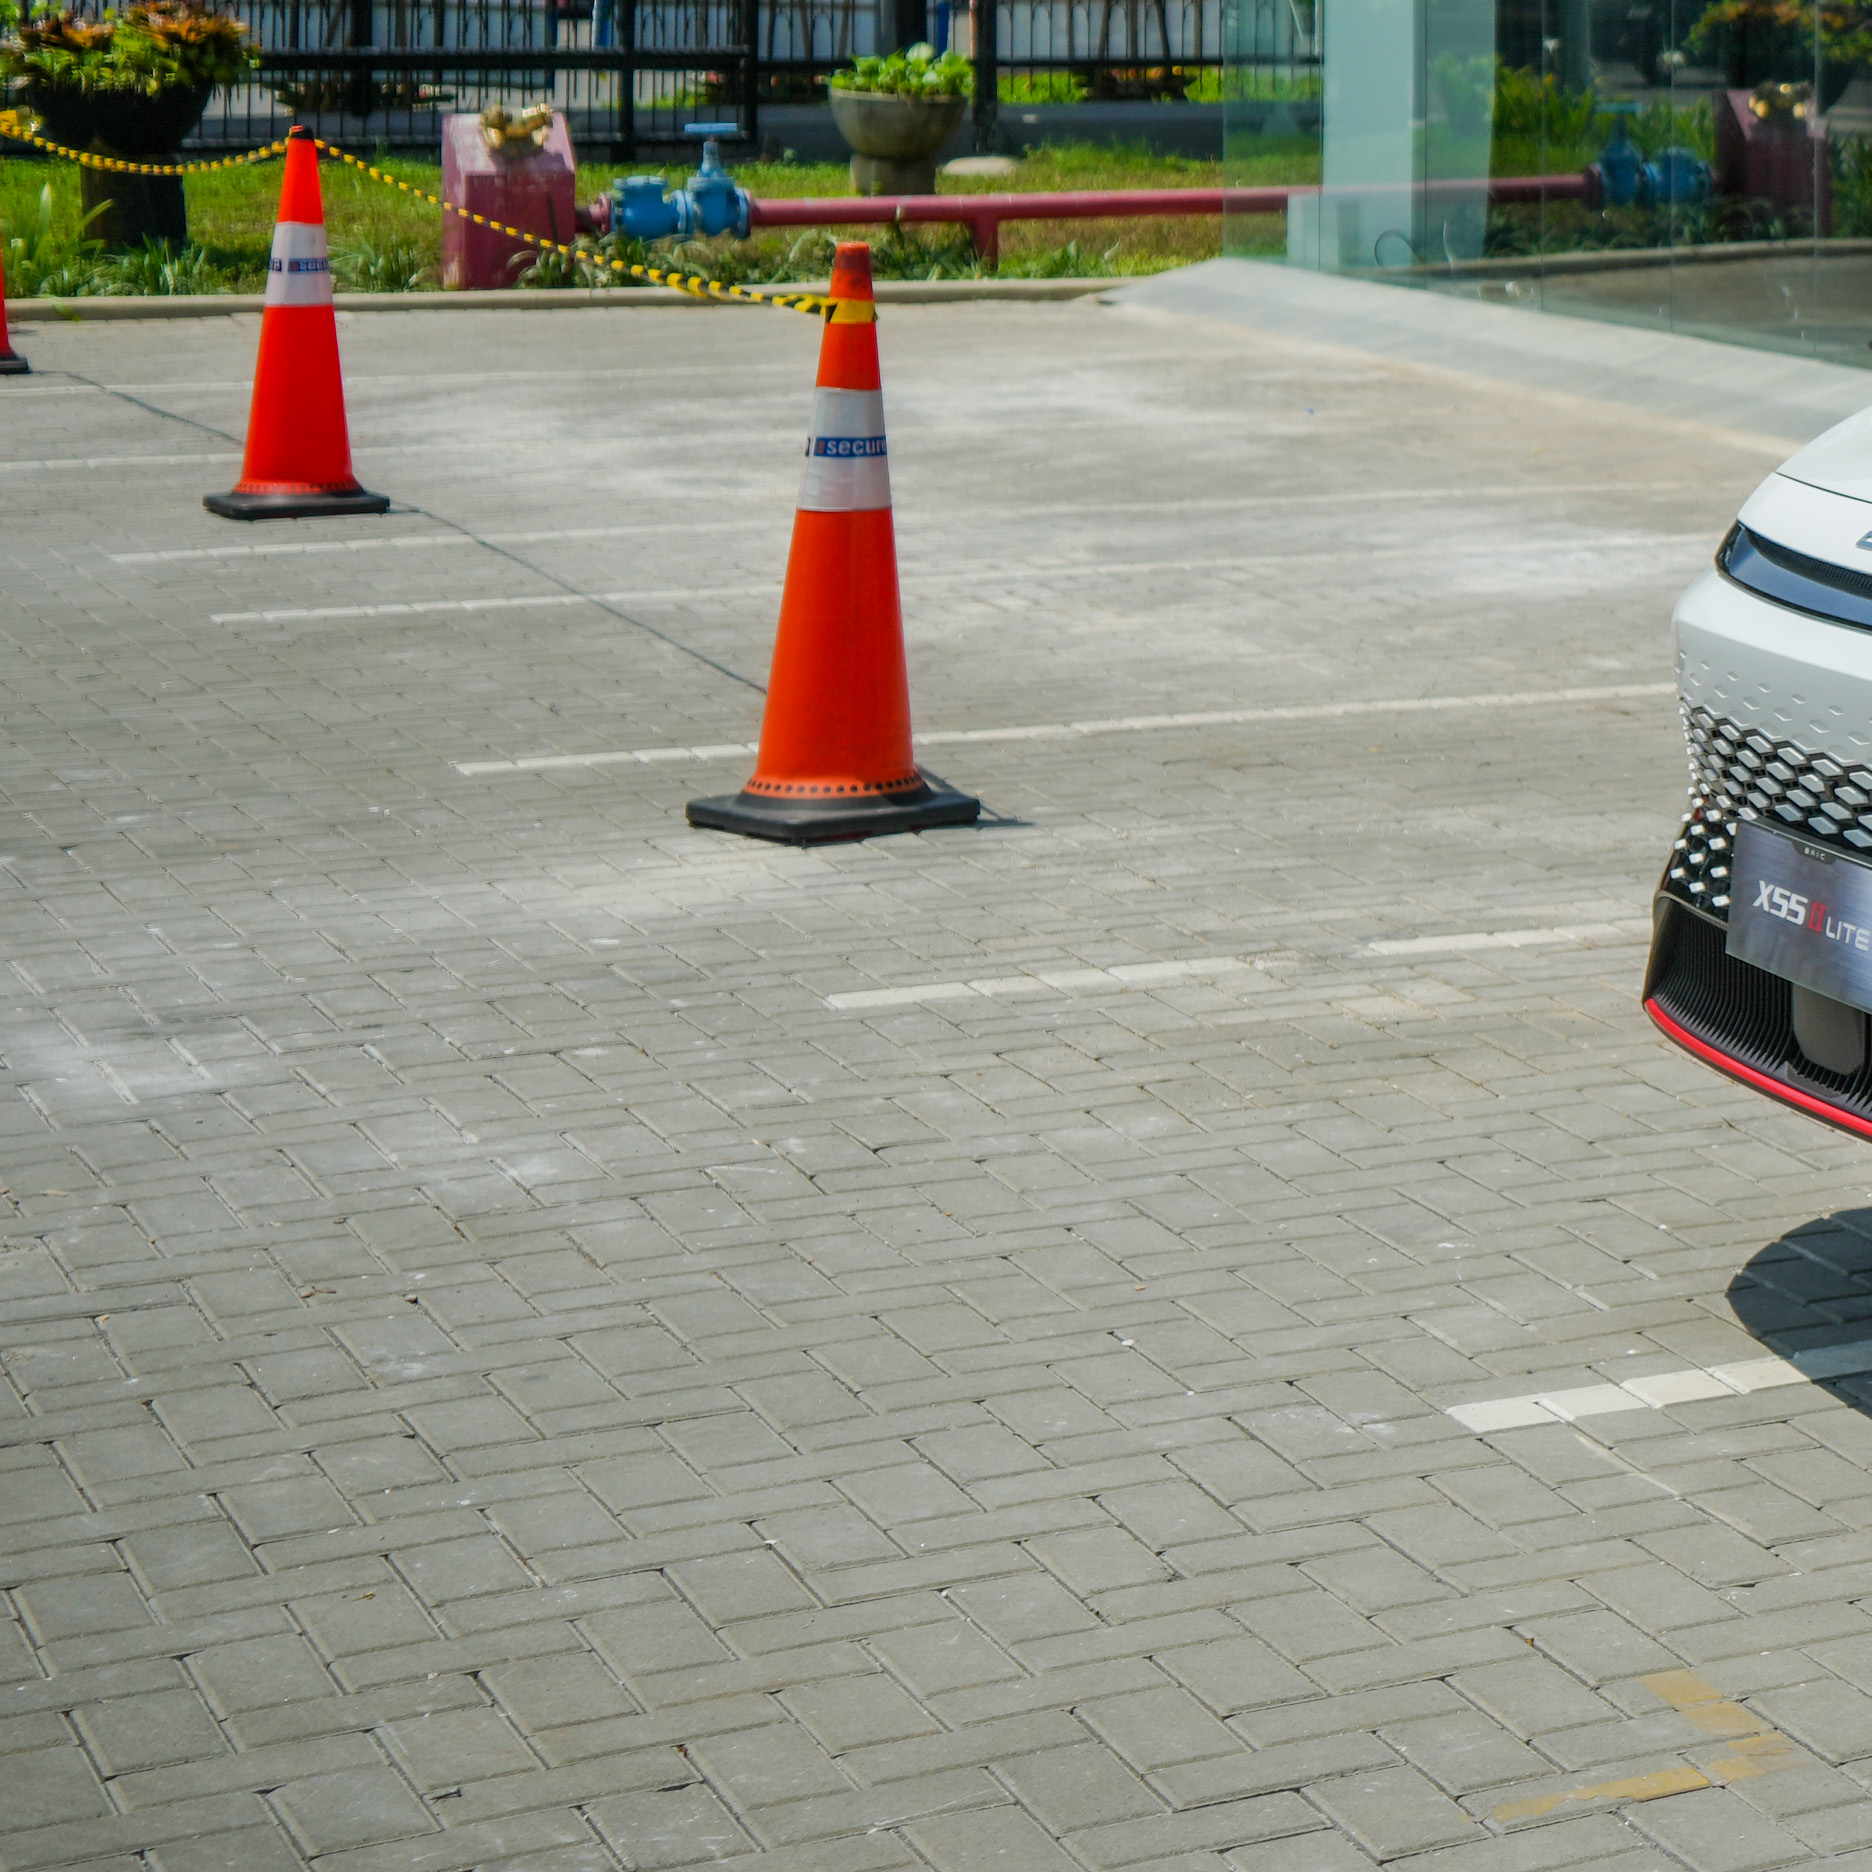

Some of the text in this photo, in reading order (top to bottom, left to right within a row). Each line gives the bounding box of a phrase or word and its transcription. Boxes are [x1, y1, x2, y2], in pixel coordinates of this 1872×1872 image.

[1804, 846, 1826, 861] BAIC
[1753, 880, 1808, 926] X55
[1826, 916, 1871, 951] LITE
